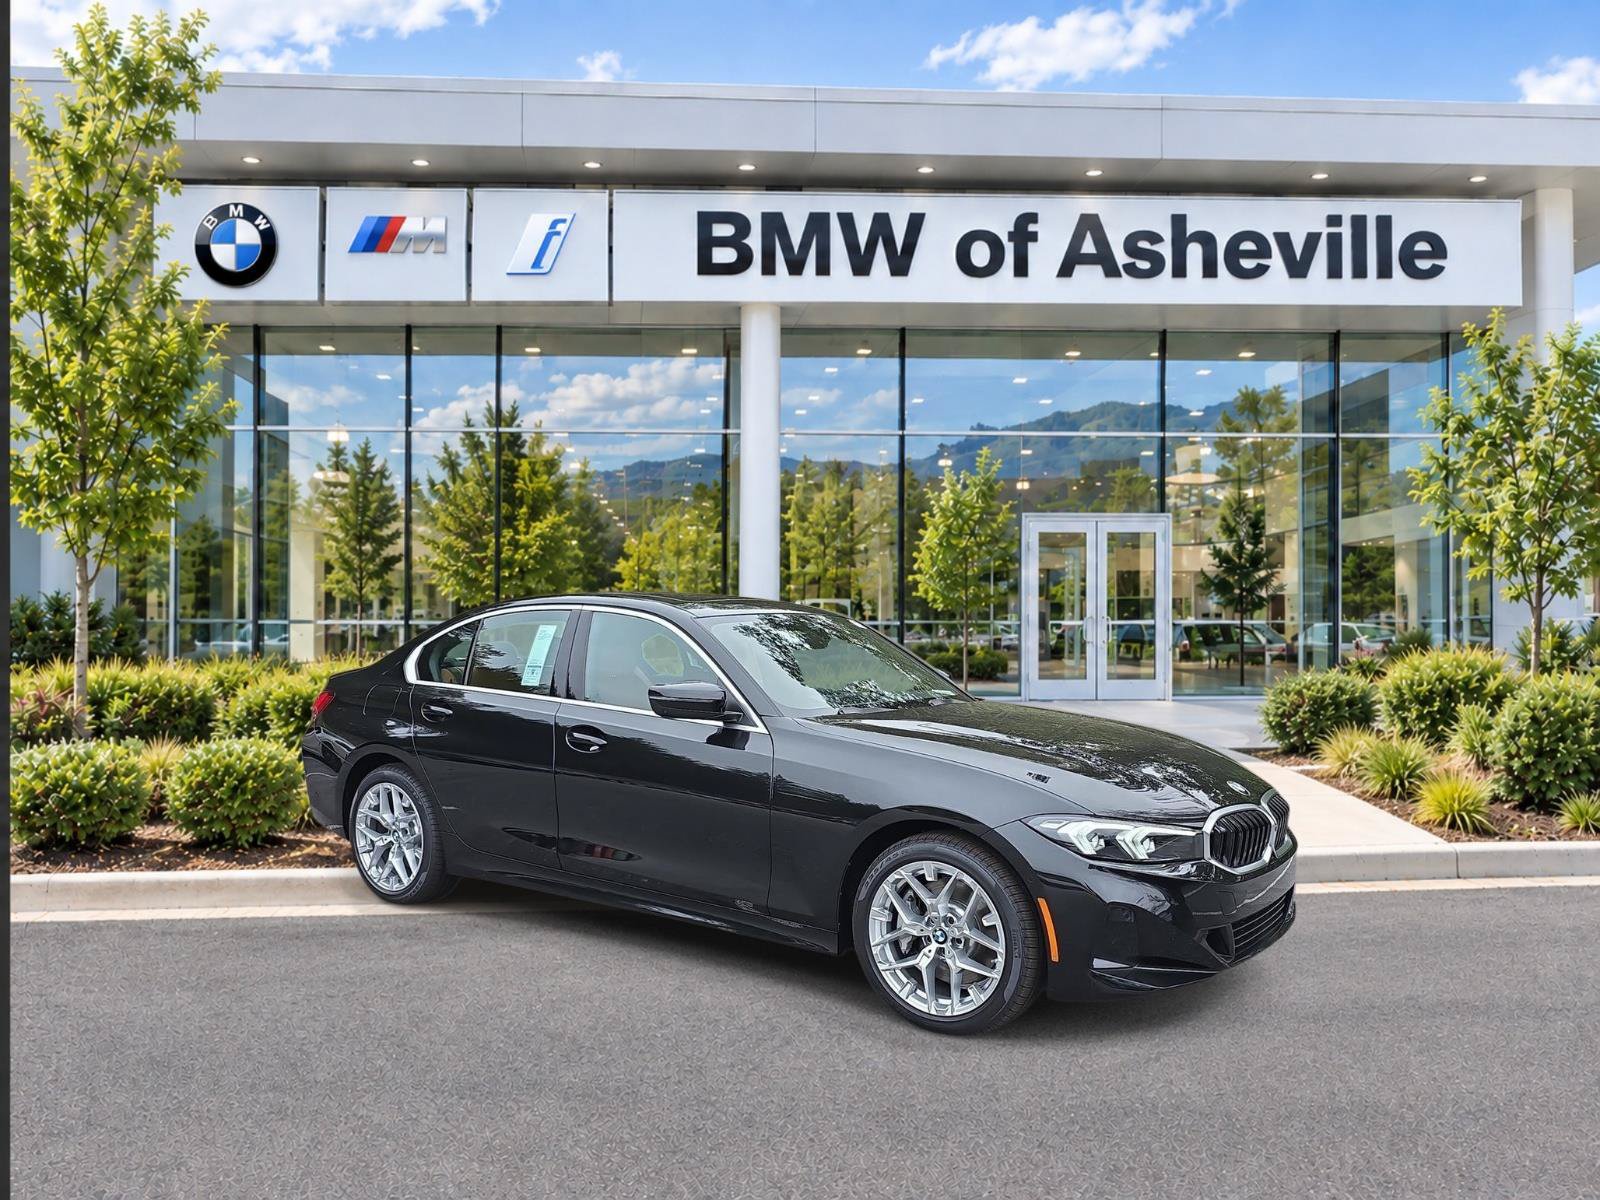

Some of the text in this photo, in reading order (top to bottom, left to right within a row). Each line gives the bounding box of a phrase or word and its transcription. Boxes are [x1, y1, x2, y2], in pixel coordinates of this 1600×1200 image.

[202, 204, 271, 231] BMW
[696, 211, 1448, 281] BMW of Asheville
